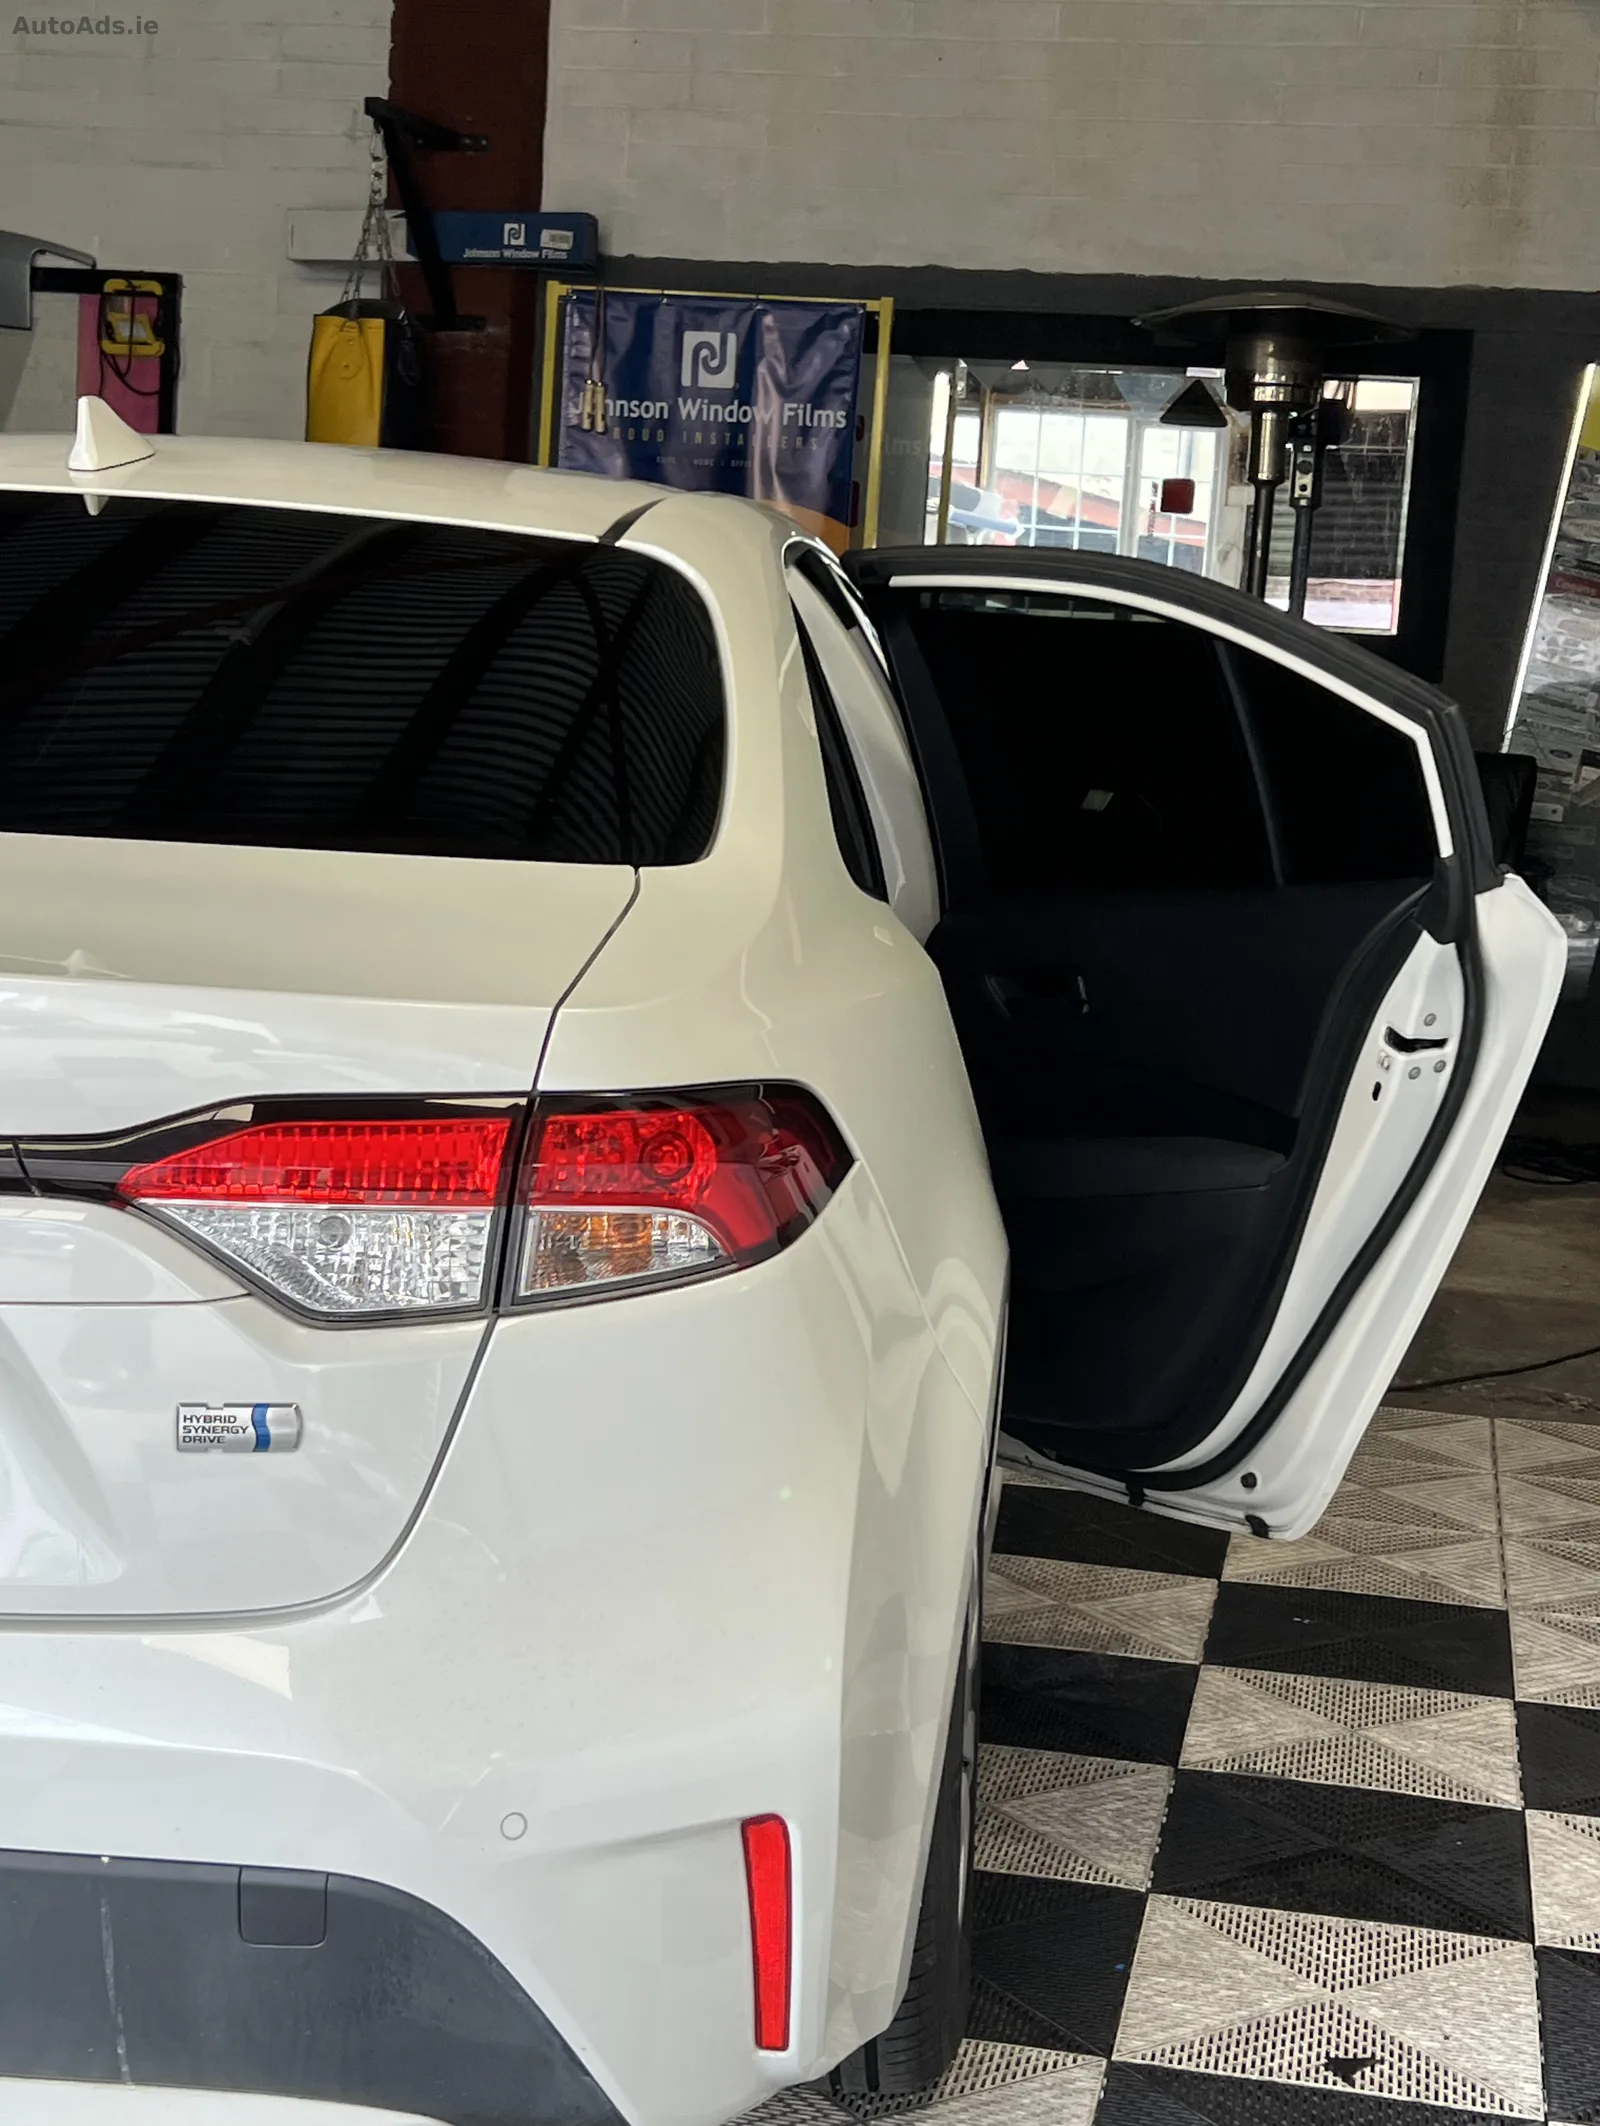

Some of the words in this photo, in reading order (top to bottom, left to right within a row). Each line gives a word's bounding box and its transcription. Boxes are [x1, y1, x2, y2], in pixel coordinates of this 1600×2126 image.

[502, 248, 540, 259] Window
[542, 248, 568, 259] Films
[677, 397, 777, 425] Window
[782, 402, 847, 429] Films
[182, 1414, 237, 1424] HYBRID
[182, 1425, 249, 1435] SYNERGY
[182, 1435, 226, 1444] DRIVE
